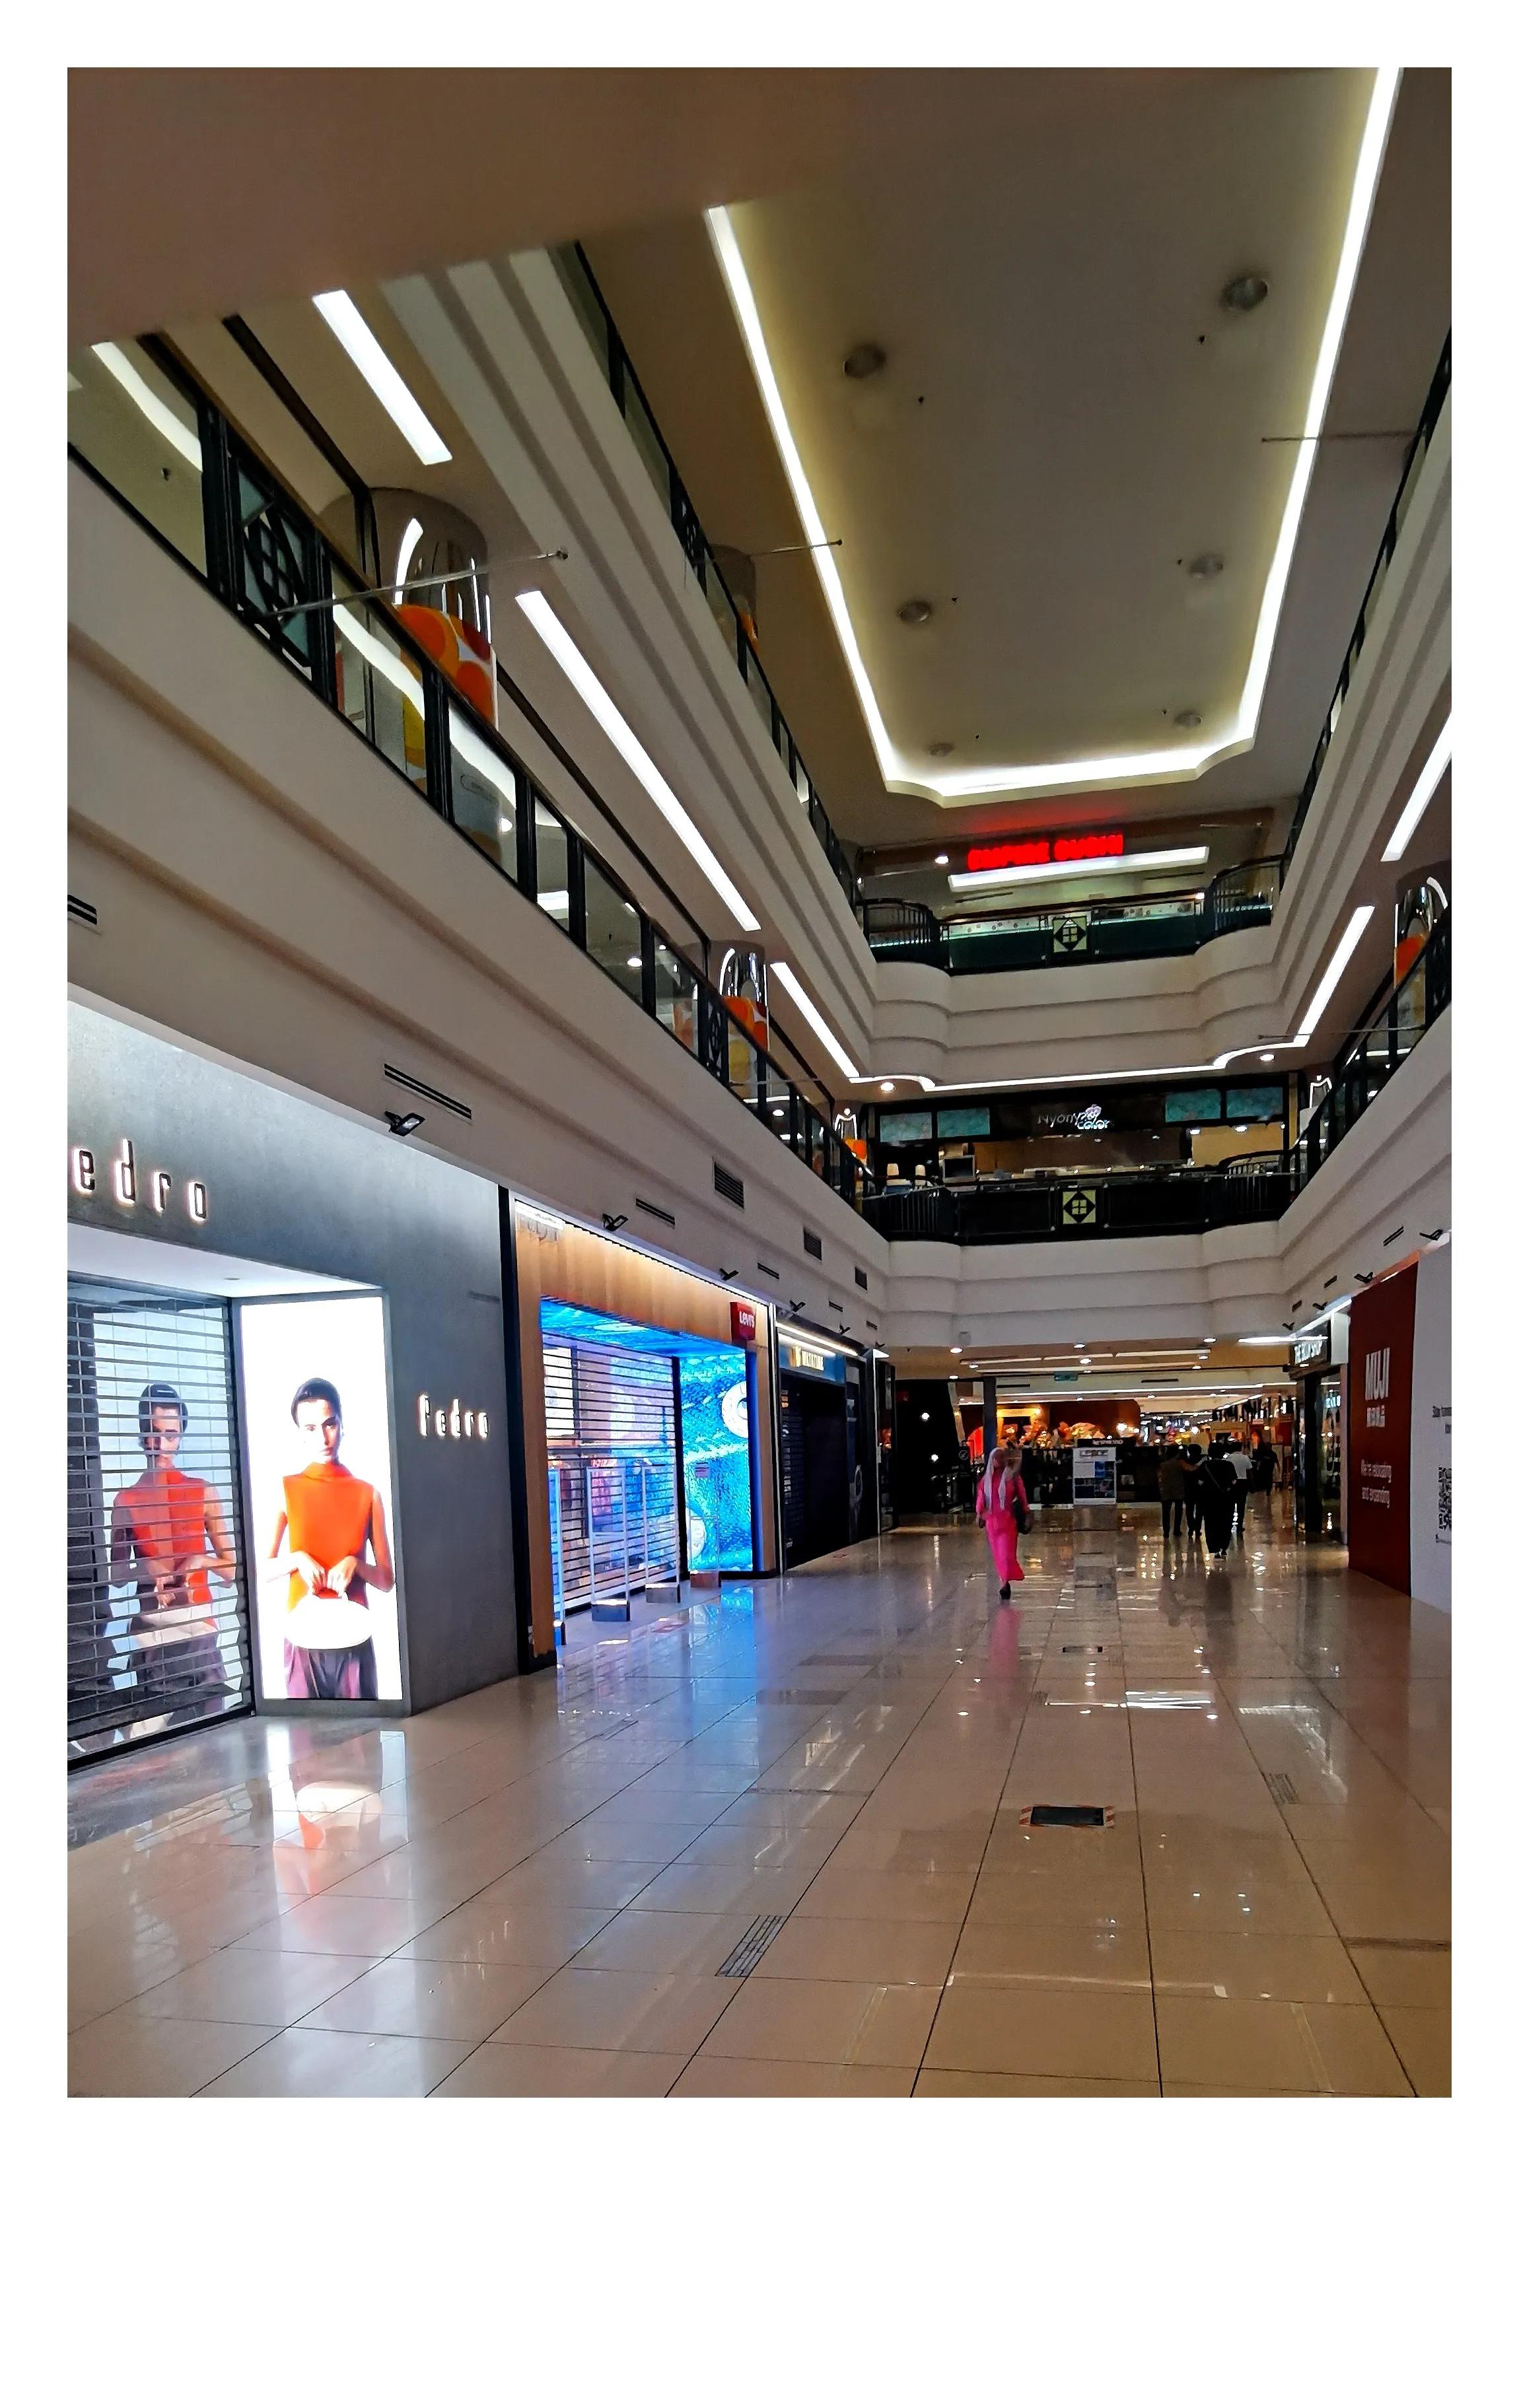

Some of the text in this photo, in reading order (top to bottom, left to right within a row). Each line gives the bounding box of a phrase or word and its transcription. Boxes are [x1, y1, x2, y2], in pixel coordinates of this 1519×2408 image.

[74, 1138, 207, 1223] edro
[1365, 1347, 1390, 1400] MUJI
[419, 1393, 490, 1439] Pedro
